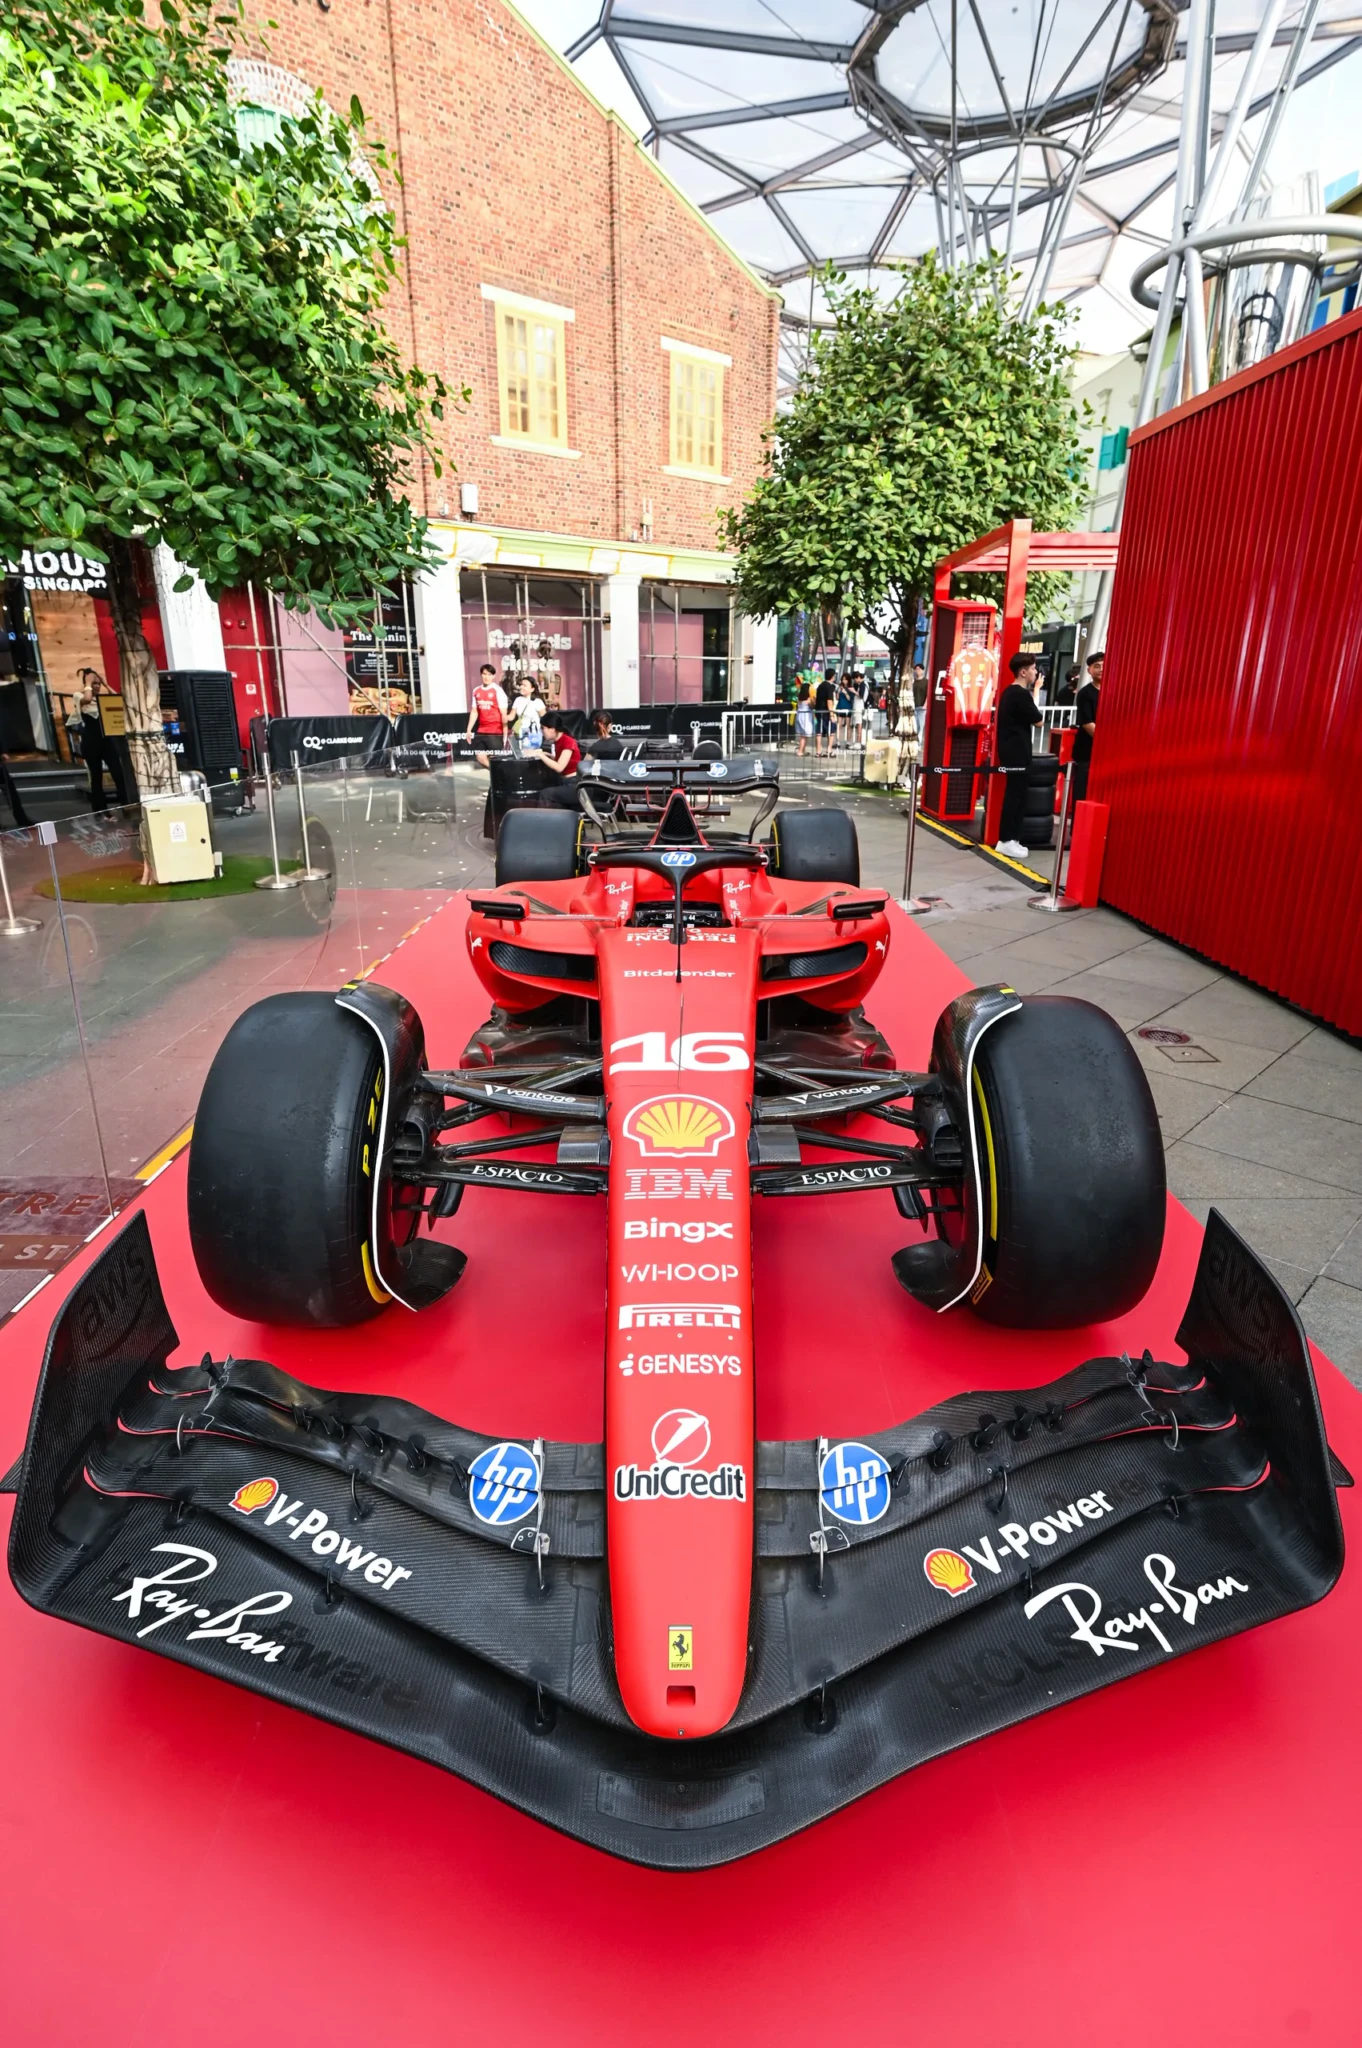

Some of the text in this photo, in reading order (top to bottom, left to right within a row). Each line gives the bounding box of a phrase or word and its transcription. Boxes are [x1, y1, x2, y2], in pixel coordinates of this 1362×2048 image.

[501, 655, 561, 671] fiesta
[303, 736, 323, 750] CQ
[666, 851, 693, 866] hp
[624, 969, 736, 977] Bitdefender
[609, 1031, 750, 1076] 16
[507, 1087, 577, 1103] vantage
[811, 1085, 882, 1099] vantage
[471, 1165, 563, 1183] ESPACIO
[624, 1168, 734, 1200] IBM
[801, 1166, 892, 1185] ESPACIO
[621, 1263, 739, 1283] WHOOP
[619, 1303, 742, 1330] PIRELLI
[638, 1354, 742, 1376] GENESYS
[474, 1444, 537, 1524] hp
[615, 1466, 745, 1501] UniCredit
[829, 1444, 885, 1524] hp
[263, 1493, 413, 1591] V-Power
[960, 1489, 1115, 1575] V-Power
